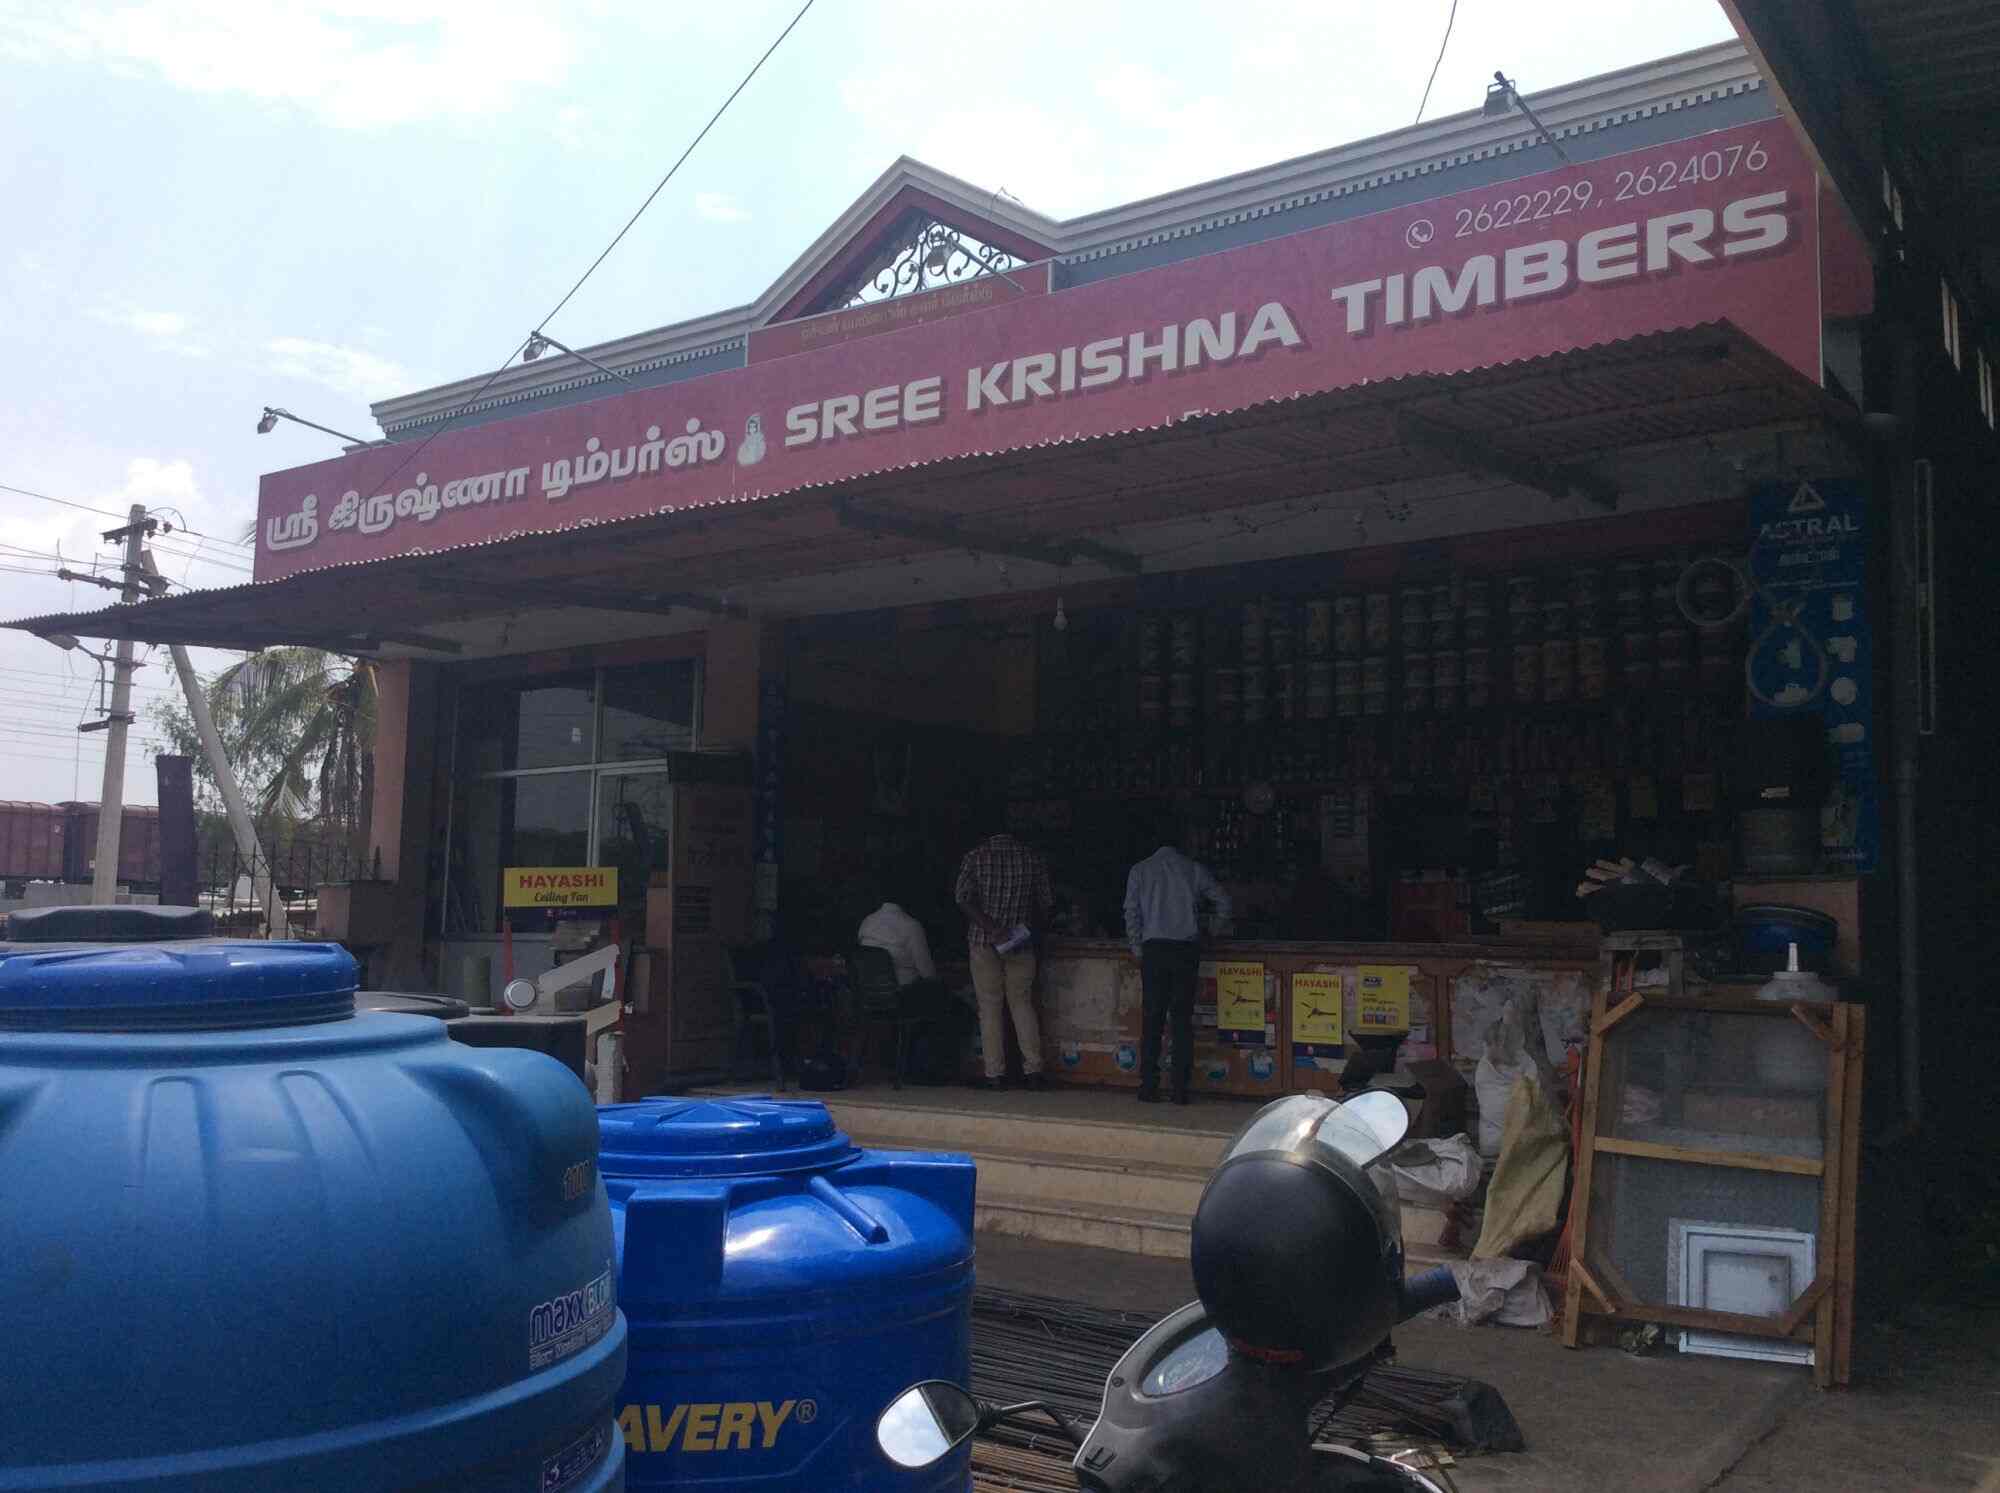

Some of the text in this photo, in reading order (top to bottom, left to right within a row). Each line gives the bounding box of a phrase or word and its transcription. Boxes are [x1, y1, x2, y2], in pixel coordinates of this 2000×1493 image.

[1455, 140, 1769, 239] 2622229, 2624076
[784, 375, 942, 446] SREE
[967, 301, 1302, 410] KRISHNA
[1330, 191, 1788, 335] TIMBERS
[541, 417, 726, 498] டிம்பர்ஸ்
[1760, 512, 1860, 539] ASTRAL
[519, 874, 605, 889] HAYASHI
[1219, 967, 1263, 977] HAYASHI
[1296, 978, 1340, 989] HAYASHI
